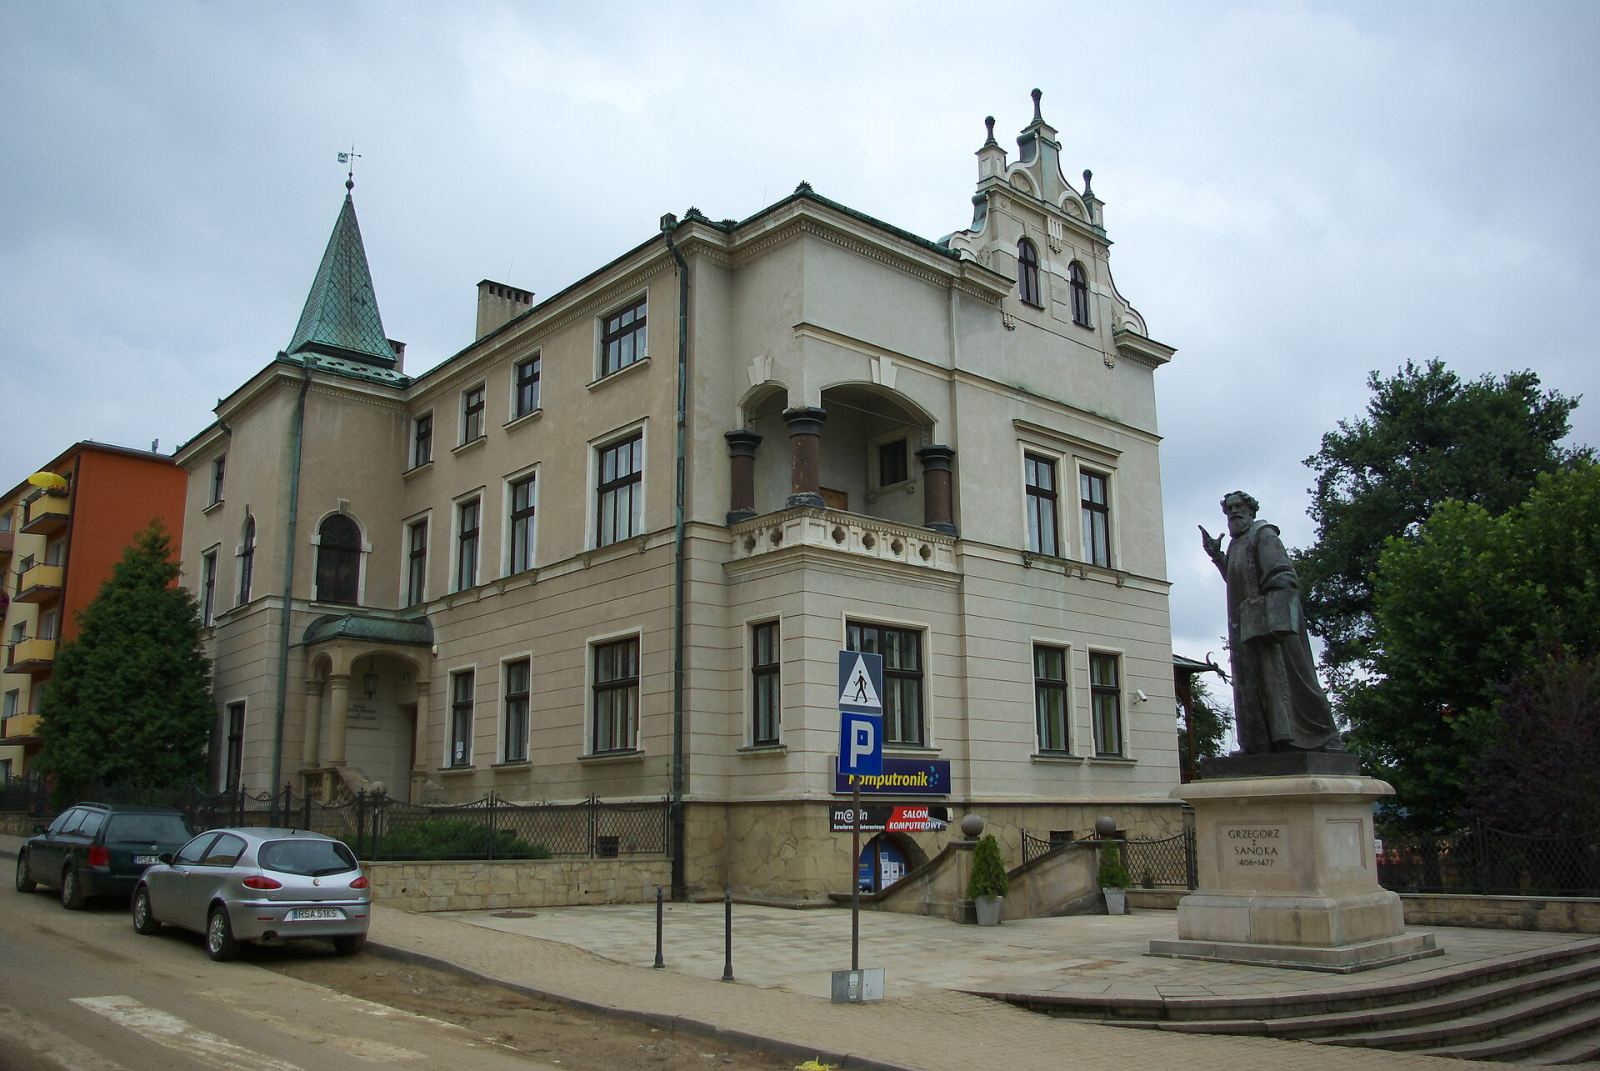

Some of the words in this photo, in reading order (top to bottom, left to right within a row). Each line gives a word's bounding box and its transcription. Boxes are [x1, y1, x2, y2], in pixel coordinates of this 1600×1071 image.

[850, 720, 875, 768] P
[902, 809, 928, 819] SALON
[889, 821, 942, 830] KOMPUTEROWY
[1228, 829, 1280, 839] GRZEGORZ
[1234, 846, 1278, 855] SANOKA
